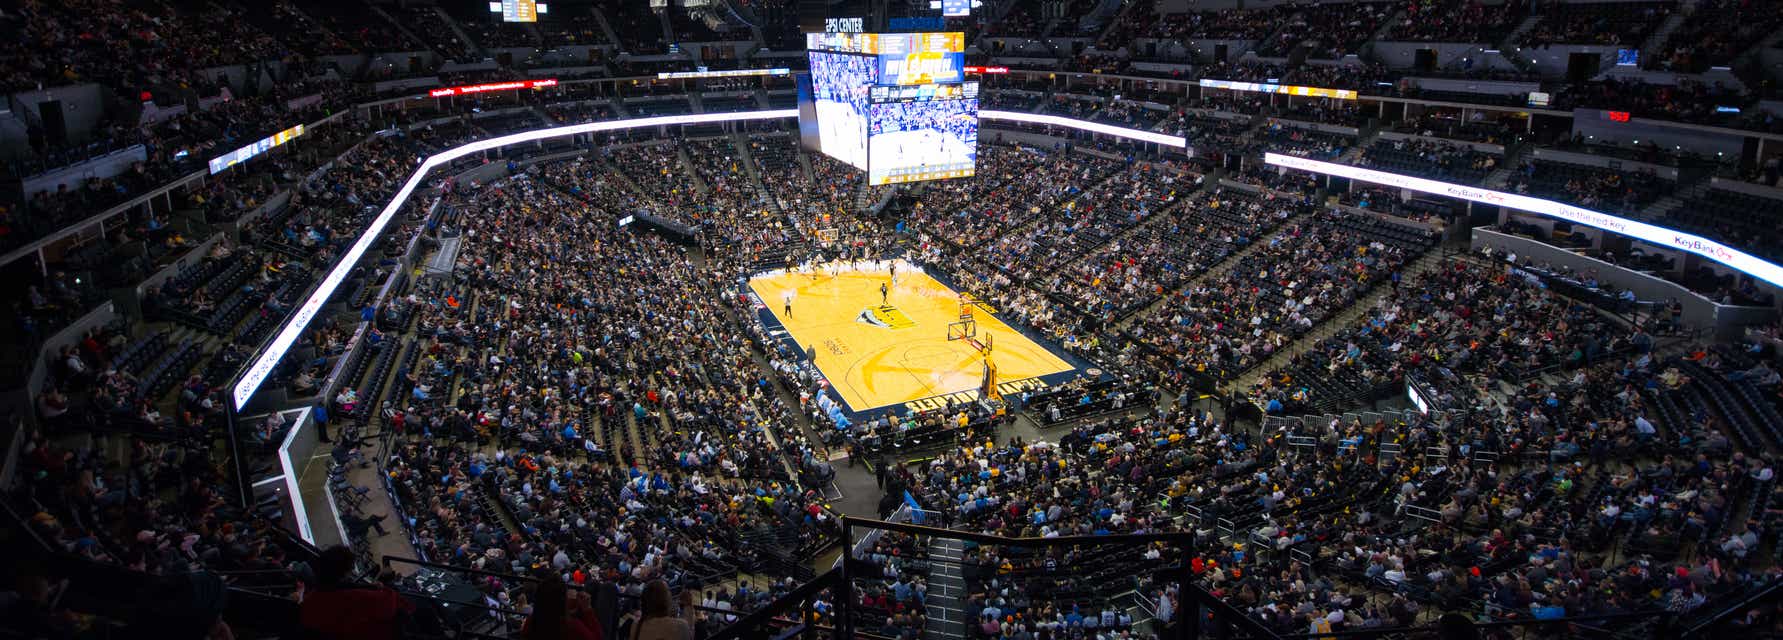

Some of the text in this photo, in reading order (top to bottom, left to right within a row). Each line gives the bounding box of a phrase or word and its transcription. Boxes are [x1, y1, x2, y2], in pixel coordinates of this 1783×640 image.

[839, 17, 863, 32] CENTER
[1447, 186, 1483, 199] KeyBank
[1592, 214, 1608, 226] red
[1674, 236, 1715, 254] KeyBank
